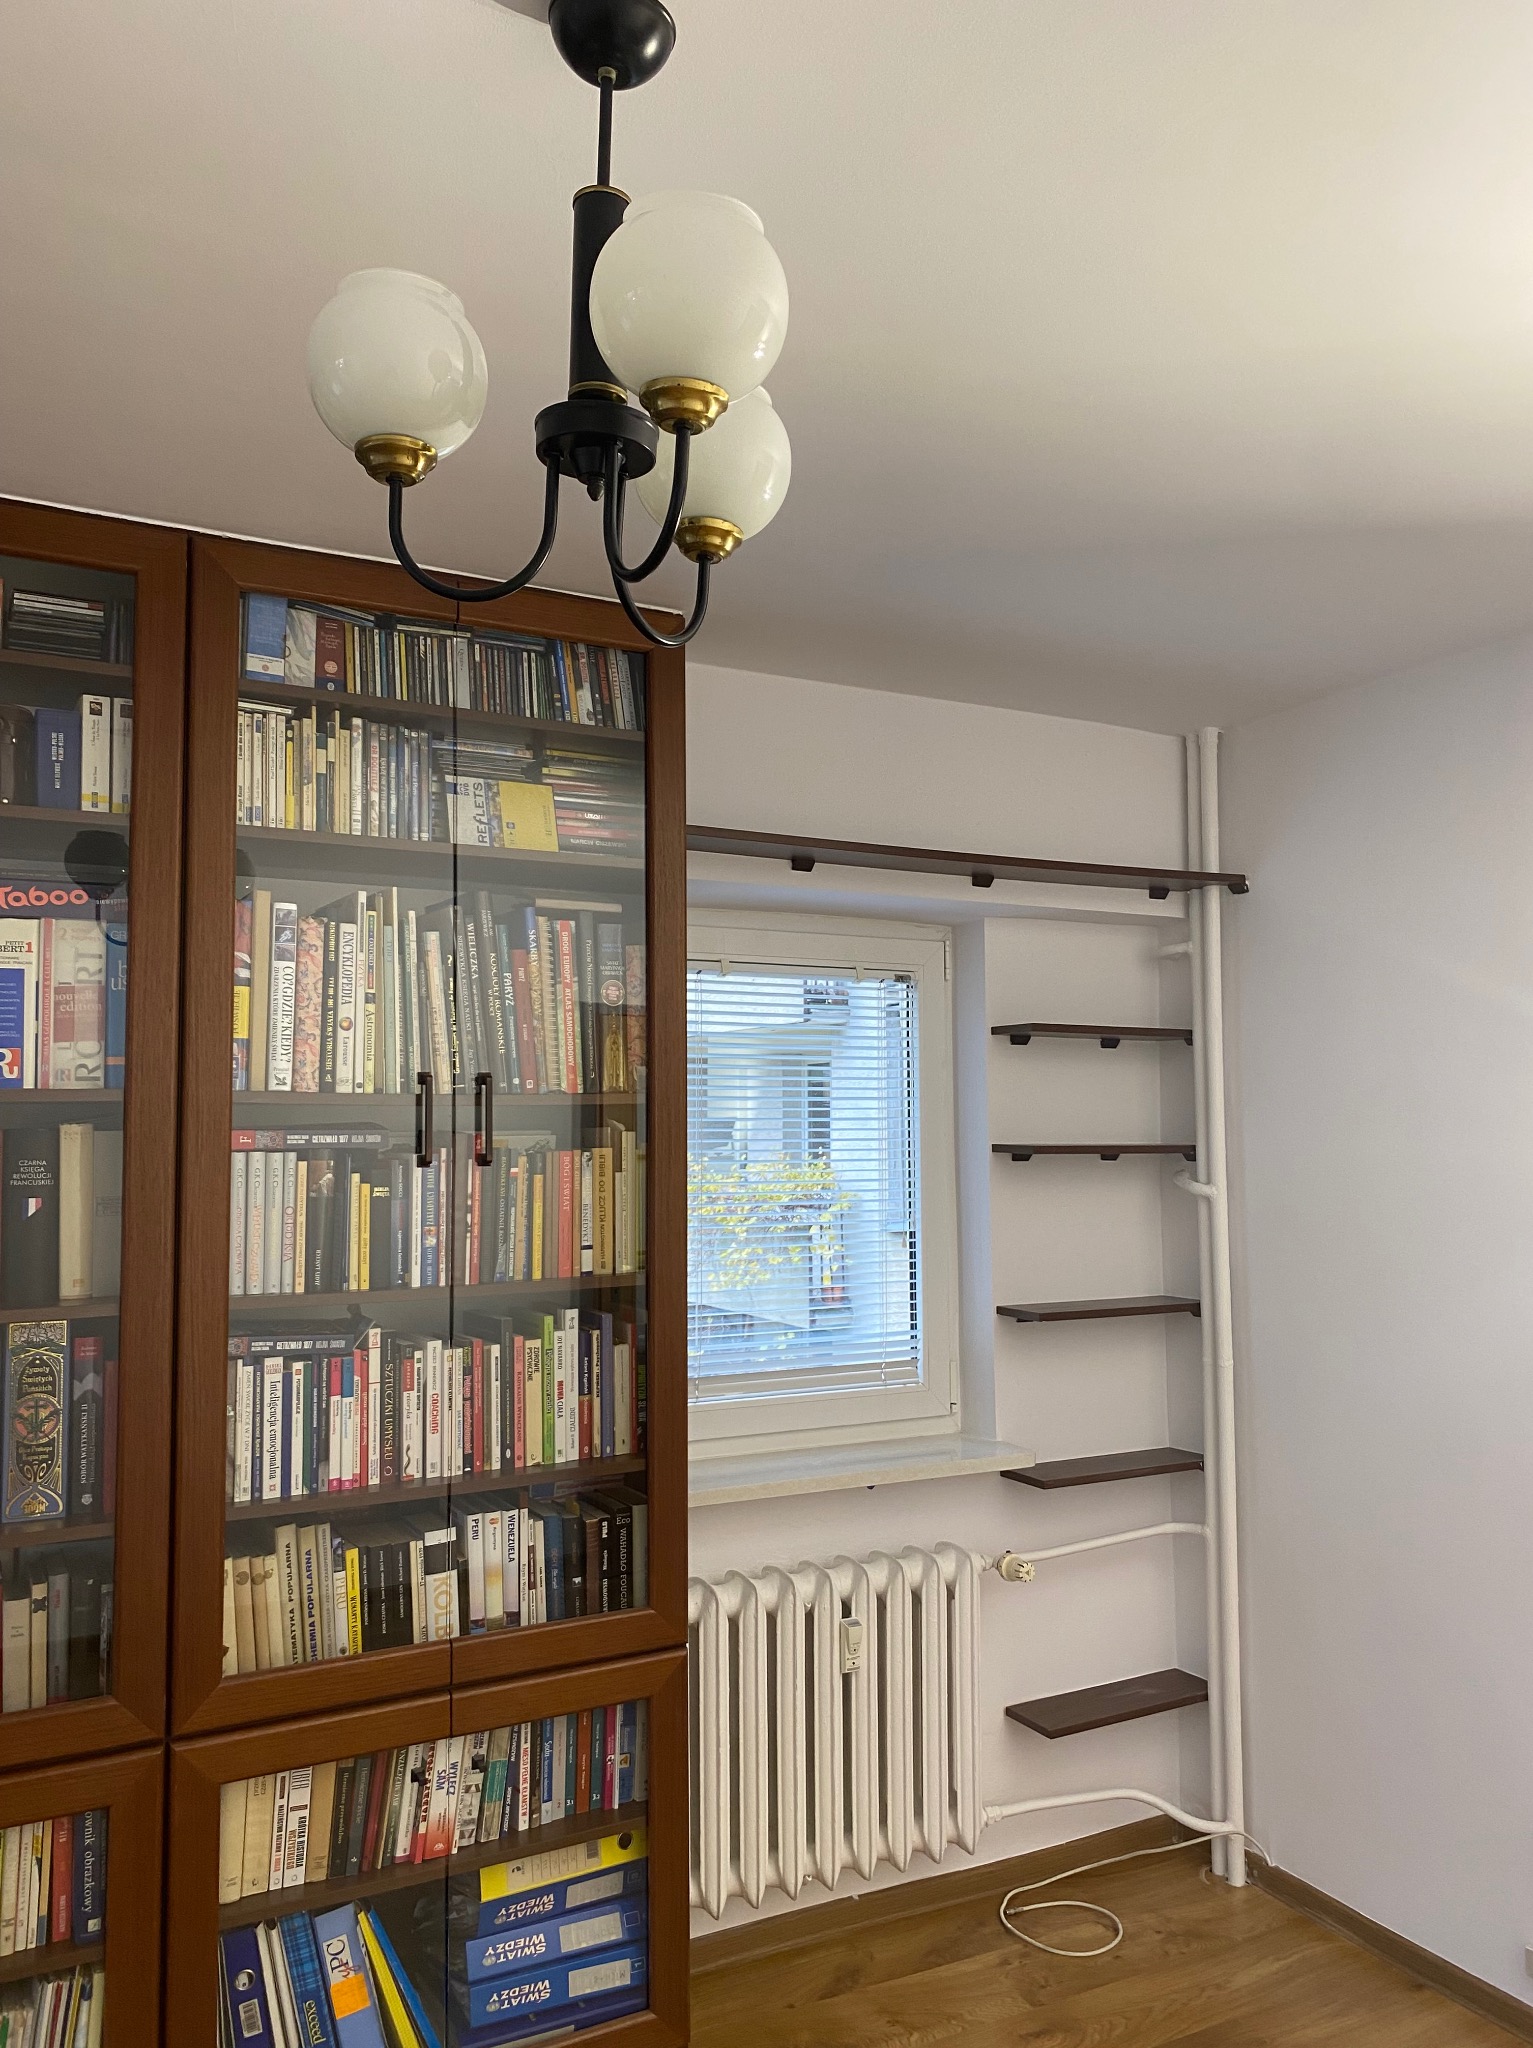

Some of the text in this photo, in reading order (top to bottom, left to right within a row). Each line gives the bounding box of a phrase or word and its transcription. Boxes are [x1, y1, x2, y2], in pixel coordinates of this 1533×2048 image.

[0, 886, 88, 910] Taboo
[457, 935, 466, 977] NIEZWYKŁA
[467, 923, 479, 979] WIELICZKA
[528, 929, 539, 967] SKARBY
[341, 931, 353, 1005] ENCYKLOPEDIA
[518, 968, 526, 982] PARYŻ
[489, 953, 505, 1054] KOŚCIOŁY ROMAŃSKIE
[503, 972, 514, 1006] PARYŻ
[562, 932, 575, 1067] DROGI EUROPY ATLAS SAMOCHODOWY
[325, 1011, 333, 1035] ŚWIATA
[365, 1009, 375, 1062] Astronomia
[427, 1168, 435, 1225] ZAKŁADNICY DIABŁA
[563, 1184, 571, 1211] ŚWIAT
[599, 1180, 606, 1192] DO
[384, 1363, 394, 1460] SZTUCZKI UMYSŁU
[405, 1393, 413, 1419] retoryka
[267, 1380, 280, 1480] Inteligencja emocjonalna
[471, 1519, 479, 1540] PERU
[619, 1528, 627, 1571] WAHADŁO
[305, 1548, 315, 1618] POPULARNA
[335, 1576, 346, 1610] PERU
[284, 1542, 298, 1665] TEMATYKA POPULARNA
[544, 1741, 552, 1757] Soda
[435, 1770, 445, 1791] SAM
[448, 1761, 459, 1796] WYLECZ
[521, 1766, 529, 1785] PEŁNE
[337, 1773, 349, 1844] Heroiczne przywództwo
[356, 1767, 368, 1824] Heroiczne życie
[286, 1830, 297, 1870] WSZYSTKIEGO
[295, 1816, 307, 1868] KRÓTKA HISTORIA
[81, 1851, 95, 1913] obrazkowy
[498, 1893, 554, 1916] WIEDZY
[506, 1900, 555, 1921] ŚWIAT
[486, 1934, 545, 1955] WIEDZY
[497, 1943, 546, 1963] ŚWIAT
[490, 1980, 550, 2002] WIEDZY
[501, 1989, 551, 2009] ŚWIAT
[306, 2000, 326, 2044] exceed
